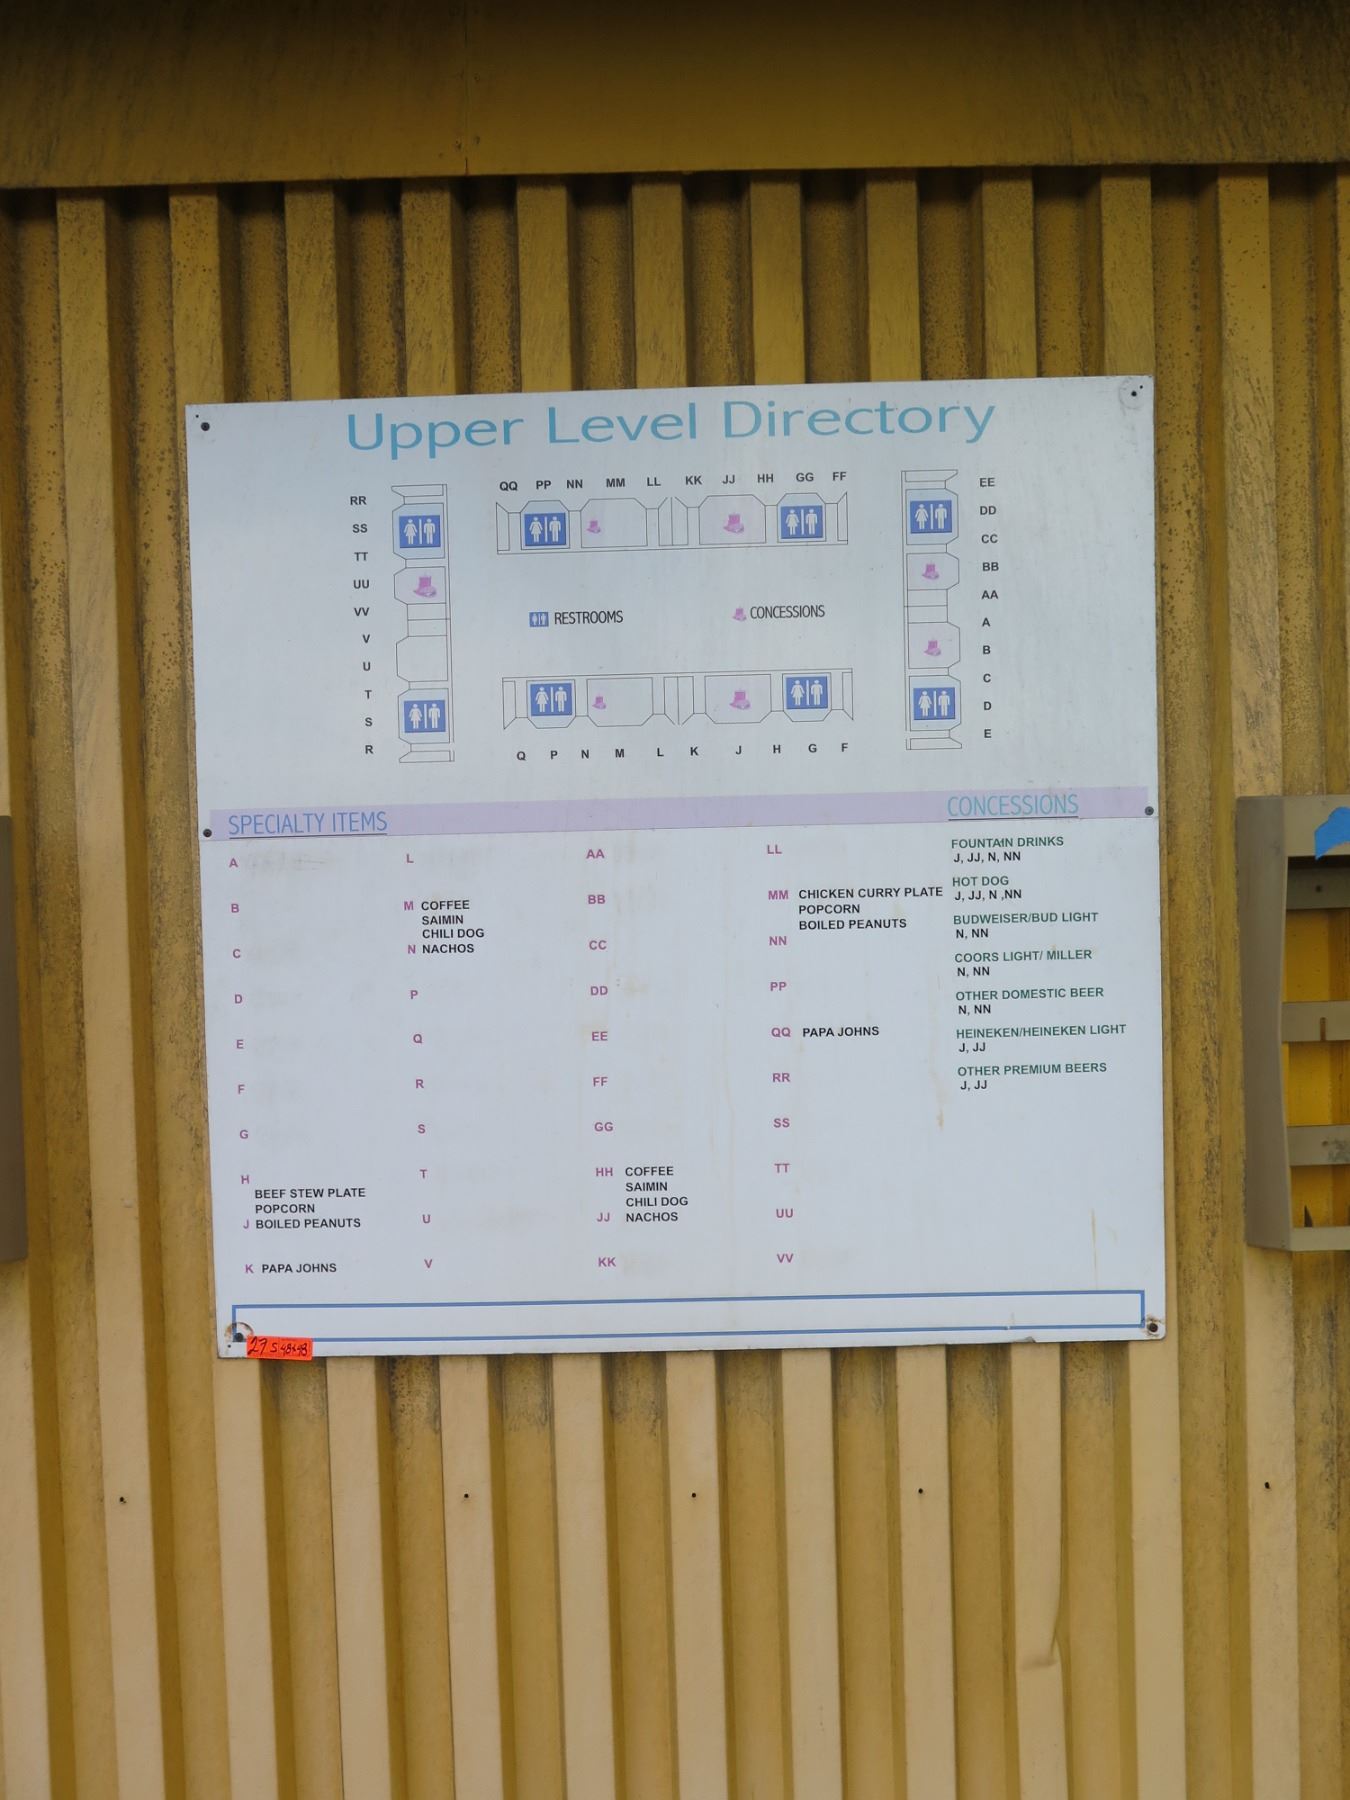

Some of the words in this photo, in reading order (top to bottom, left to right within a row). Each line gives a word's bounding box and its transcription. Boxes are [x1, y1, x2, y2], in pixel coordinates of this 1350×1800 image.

[348, 413, 524, 461] Upper
[548, 405, 697, 444] Level
[724, 401, 995, 444] Directory
[500, 481, 517, 491] QQ
[536, 480, 551, 489] PP
[567, 479, 582, 488] NN
[606, 478, 625, 487] MM
[647, 477, 661, 486] LL
[686, 476, 702, 485] KK
[723, 475, 735, 484] JJ
[758, 474, 773, 483] HH
[796, 473, 814, 482] GG
[833, 472, 846, 481] FF
[980, 478, 995, 487] EE
[350, 496, 366, 505] RR
[980, 506, 996, 515] DD
[353, 524, 367, 533] SS
[982, 534, 998, 543] CC
[354, 552, 368, 561] TT
[983, 562, 999, 571] BB
[354, 580, 369, 589] UU
[982, 590, 998, 599] AA
[354, 607, 369, 616] VV
[750, 605, 825, 619] CONCESSIONS
[555, 610, 623, 624] RESTROOMS
[982, 618, 990, 627] A
[363, 634, 370, 643] V
[983, 645, 990, 654] B
[363, 662, 370, 671] U
[983, 674, 991, 683] C
[365, 690, 372, 699] T
[984, 701, 991, 710] D
[365, 717, 372, 726] S
[984, 729, 991, 738] E
[365, 745, 373, 754] R
[517, 751, 525, 760] Q
[551, 750, 557, 759] P
[581, 749, 589, 759] N
[615, 749, 624, 758] M
[657, 748, 664, 757] L
[690, 747, 698, 756] K
[736, 746, 741, 755] J
[773, 745, 781, 754] H
[808, 744, 817, 753] G
[842, 743, 848, 752] F
[947, 795, 1079, 817] CONCESSIONS
[229, 814, 325, 835] SPECIALTY
[333, 811, 388, 832] ITEMS
[1018, 837, 1063, 847] DRINKS
[586, 849, 604, 859] AA
[767, 845, 782, 854] LL
[229, 858, 238, 867] A
[407, 854, 414, 863] L
[954, 853, 963, 864] J,
[967, 852, 984, 863] JJ,
[988, 852, 999, 863] N,
[1004, 851, 1020, 861] NN
[953, 876, 978, 887] HOT
[982, 876, 1009, 886] DOG
[768, 890, 789, 900] MM
[799, 889, 854, 899] CHICKEN
[858, 888, 900, 898] CURRY
[904, 887, 943, 897] PLATE
[955, 891, 964, 902] J,
[968, 890, 985, 901] JJ,
[588, 895, 606, 904] BB
[231, 903, 239, 913] B
[403, 901, 414, 910] M
[421, 900, 470, 911] COFFEE
[799, 904, 860, 914] POPCORN
[422, 915, 463, 925] SAIMIN
[954, 912, 1058, 924] BUDWEISER/BUD
[1062, 912, 1098, 922] LIGHT
[799, 920, 844, 930] BOILED
[849, 919, 907, 929] PEANUTS
[422, 929, 453, 939] CHILI
[457, 928, 484, 938] DOG
[956, 929, 967, 939] N,
[972, 928, 988, 938] NN
[589, 940, 606, 950] CC
[769, 936, 787, 946] NN
[233, 949, 240, 958] C
[408, 945, 416, 954] N
[423, 944, 474, 954] NACHOS
[955, 952, 999, 963] COORS
[1003, 951, 1043, 961] LIGHT/
[1047, 950, 1092, 960] MILLER
[957, 967, 969, 977] N,
[973, 966, 989, 976] NN
[591, 986, 608, 996] DD
[770, 982, 787, 991] PP
[235, 994, 242, 1004] D
[410, 990, 418, 999] P
[956, 991, 998, 1001] OTHER
[1002, 988, 1066, 999] DOMESTIC
[1070, 987, 1103, 997] BEER
[958, 1005, 970, 1016] N,
[974, 1004, 991, 1014] NN
[592, 1031, 607, 1041] EE
[771, 1027, 791, 1037] QQ
[803, 1028, 835, 1037] PAPA
[838, 1026, 879, 1036] JOHNS
[956, 1025, 1085, 1039] HEINEKEN/HEINEKEN
[1090, 1024, 1126, 1034] LIGHT
[413, 1034, 422, 1044] Q
[236, 1040, 243, 1049] E
[959, 1043, 969, 1053] J,
[973, 1042, 985, 1052] JJ
[958, 1066, 1000, 1076] OTHER
[1004, 1064, 1061, 1075] PREMIUM
[1065, 1063, 1107, 1073] BEERS
[593, 1077, 608, 1087] FF
[773, 1073, 790, 1082] RR
[416, 1079, 424, 1088] R
[960, 1081, 970, 1091] J,
[974, 1080, 987, 1089] JJ
[238, 1084, 244, 1094] F
[595, 1122, 613, 1132] GG
[774, 1118, 790, 1128] SS
[418, 1124, 425, 1134] S
[240, 1130, 248, 1139] G
[596, 1168, 613, 1176] HH
[625, 1166, 673, 1176] COFFEE
[774, 1163, 790, 1173] TT
[420, 1169, 427, 1178] T
[241, 1175, 249, 1184] H
[626, 1182, 667, 1192] SAIMIN
[255, 1189, 286, 1199] BEEF
[290, 1189, 324, 1198] STEW
[328, 1188, 365, 1197] PLATE
[626, 1197, 657, 1207] CHILI
[661, 1197, 688, 1207] DOG
[256, 1204, 315, 1214] POPCORN
[776, 1209, 793, 1218] UU
[423, 1215, 430, 1223] U
[597, 1213, 610, 1222] JJ
[626, 1212, 678, 1222] NACHOS
[243, 1220, 249, 1229] J
[256, 1219, 300, 1229] BOILED
[304, 1218, 360, 1228] PEANUTS
[424, 1259, 432, 1268] V
[598, 1257, 616, 1267] KK
[777, 1254, 793, 1263] VV
[245, 1264, 254, 1273] K
[262, 1264, 293, 1273] PAPA
[296, 1263, 336, 1273] JOHNS
